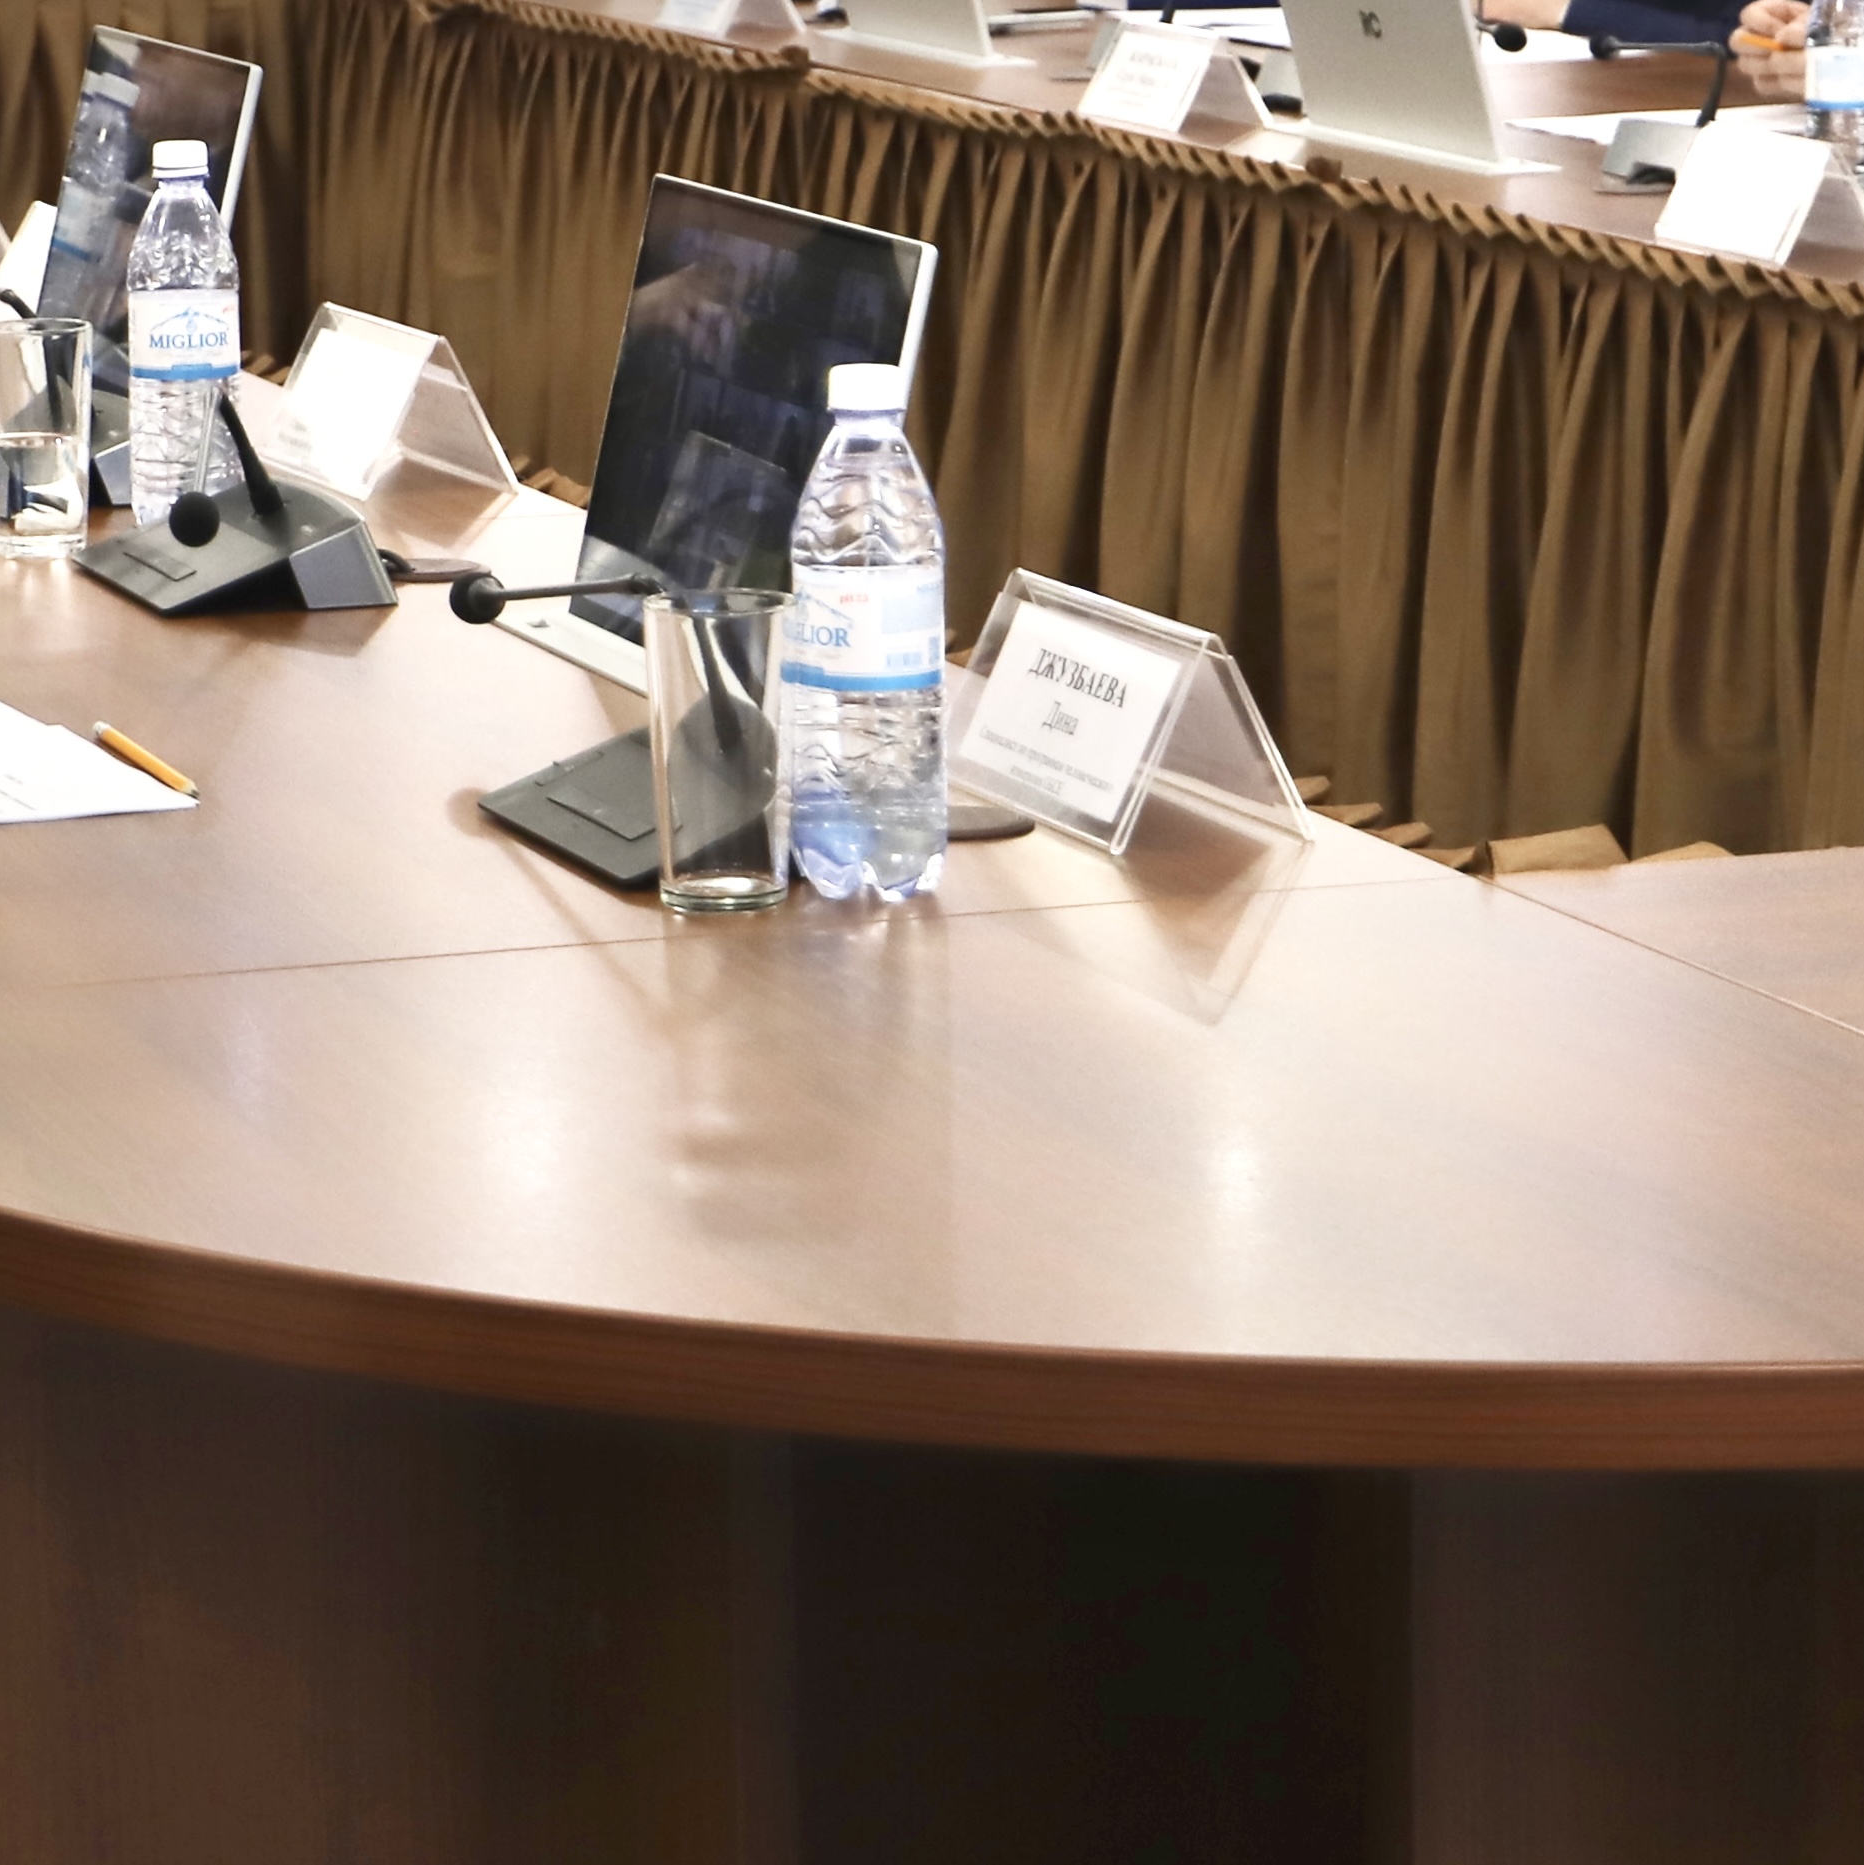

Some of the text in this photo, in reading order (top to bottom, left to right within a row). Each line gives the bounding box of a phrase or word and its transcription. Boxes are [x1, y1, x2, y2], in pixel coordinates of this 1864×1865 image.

[149, 332, 228, 350] MIGLIOR
[1027, 647, 1129, 710] ДЖУЗБАЕВА
[1040, 701, 1080, 737] Дина
